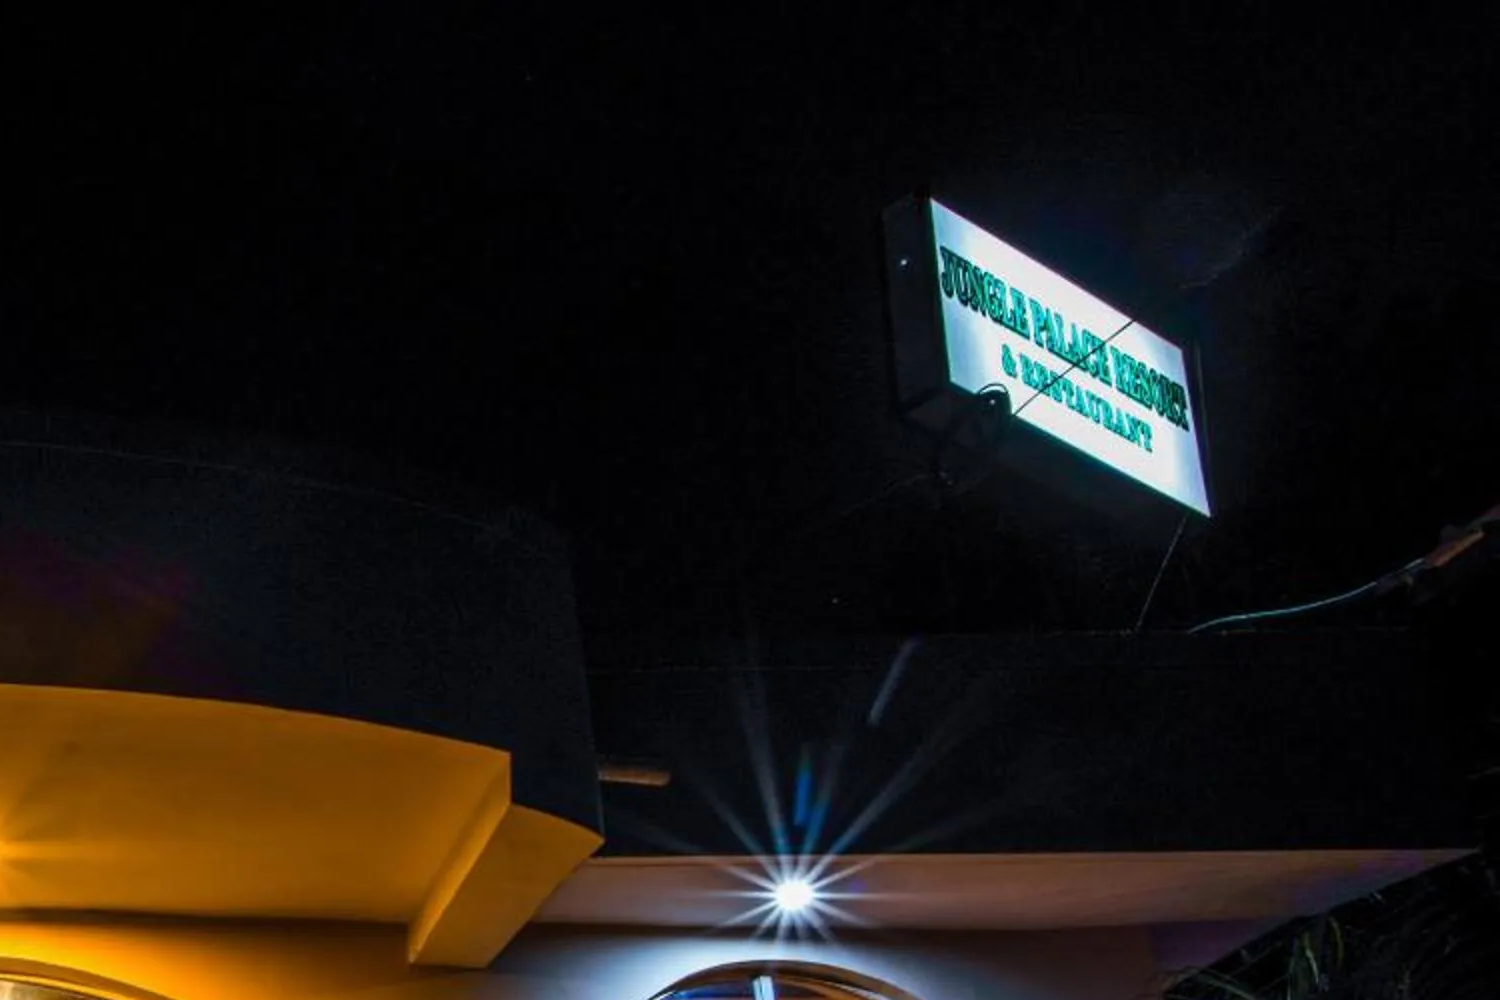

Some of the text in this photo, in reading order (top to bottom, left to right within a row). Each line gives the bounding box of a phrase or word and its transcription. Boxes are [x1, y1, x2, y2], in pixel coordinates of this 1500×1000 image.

[939, 245, 1190, 432] JUNGLE PALACE RESORT
[1001, 343, 1153, 454] & RESTAURANT
